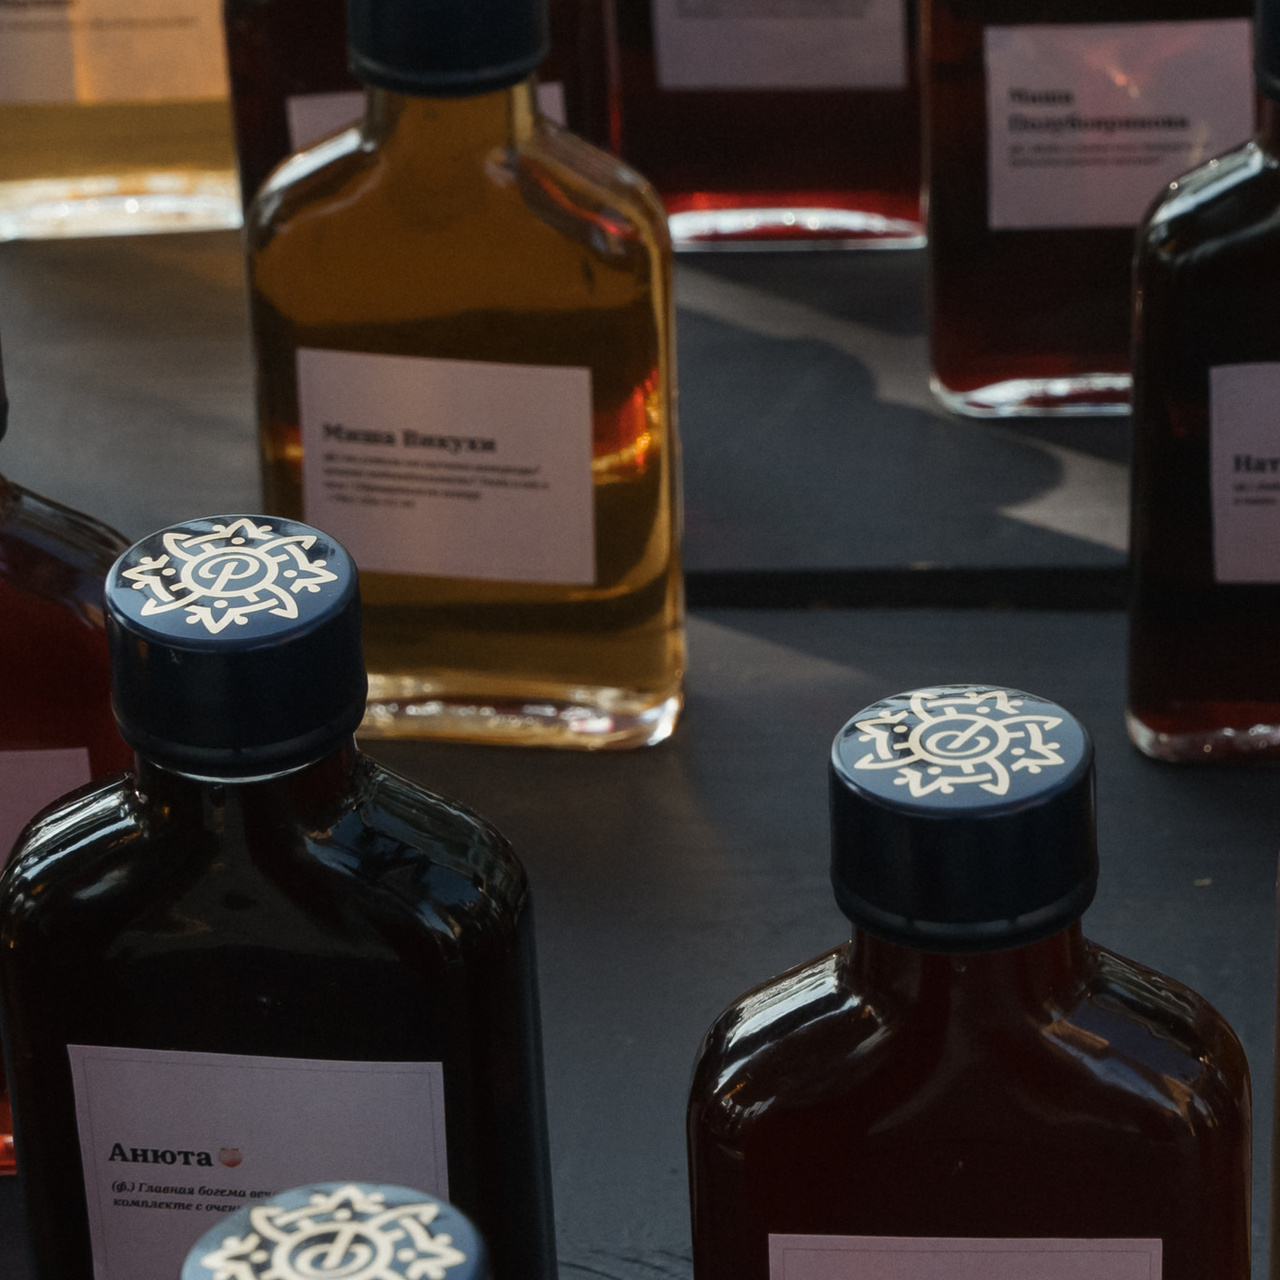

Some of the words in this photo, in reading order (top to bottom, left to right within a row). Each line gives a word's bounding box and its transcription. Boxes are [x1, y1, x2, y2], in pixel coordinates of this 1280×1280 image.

[108, 1142, 214, 1167] Анюта
[111, 1180, 136, 1194] (ф.)
[138, 1182, 195, 1196] Главная
[198, 1185, 247, 1198] богема
[249, 1188, 276, 1200] веч
[113, 1198, 192, 1211] комплекте
[195, 1202, 203, 1211] с
[205, 1202, 241, 1213] очен
